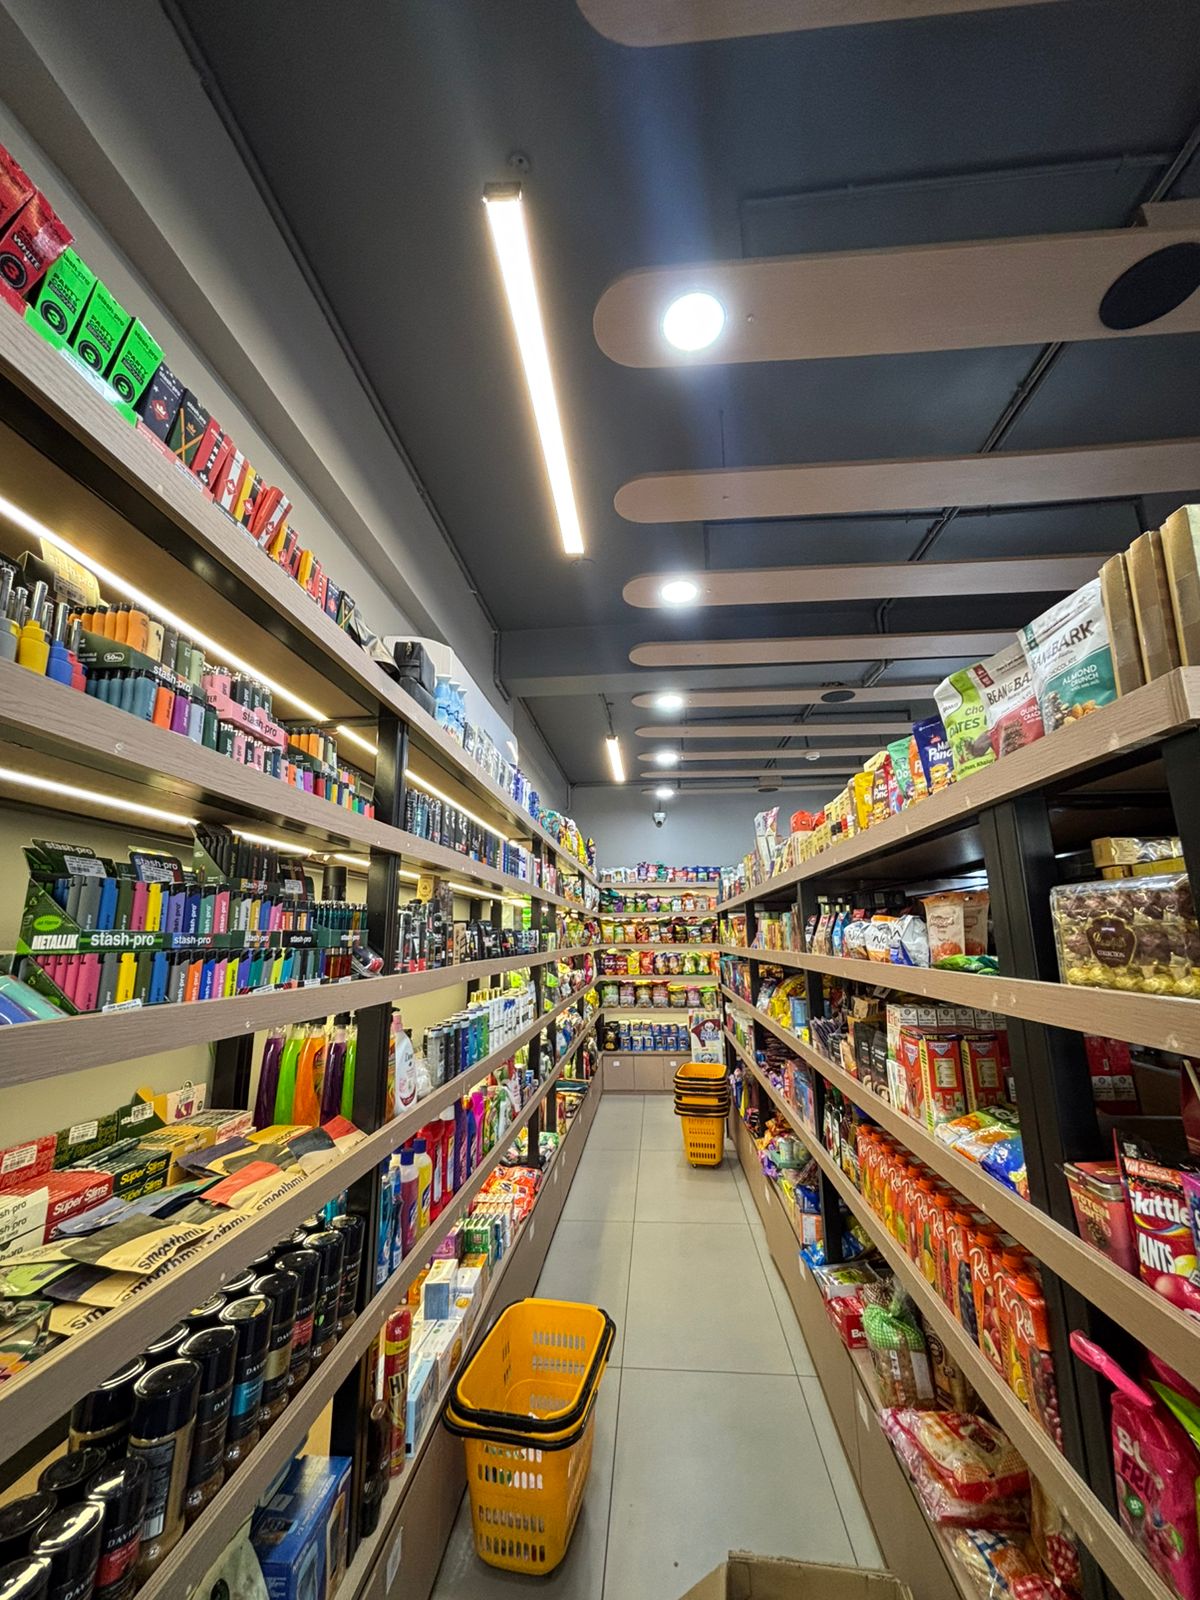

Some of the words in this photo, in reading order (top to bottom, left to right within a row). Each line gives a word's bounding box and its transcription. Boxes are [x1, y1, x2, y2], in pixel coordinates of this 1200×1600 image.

[12, 233, 41, 271] WHITE
[53, 272, 80, 303] PARTY
[47, 309, 60, 325] 3
[90, 314, 116, 344] PARTY
[84, 349, 96, 364] 3
[126, 350, 149, 377] PARTY
[117, 381, 129, 395] 3
[1062, 664, 1098, 686] ALMOND
[1070, 673, 1099, 688] CRUNCH
[986, 682, 1008, 706] BEAN
[242, 710, 278, 738] stash-pro
[135, 857, 179, 871] stash-pro
[31, 934, 79, 950] METALLIK
[90, 932, 156, 949] stash-pro
[173, 935, 212, 946] stash-pro
[1097, 950, 1126, 958] COLLECTION
[120, 1168, 145, 1185] Super
[147, 1158, 167, 1175] Slims
[144, 1177, 164, 1191] Slims
[53, 1196, 83, 1216] Super
[84, 1183, 109, 1200] Slims
